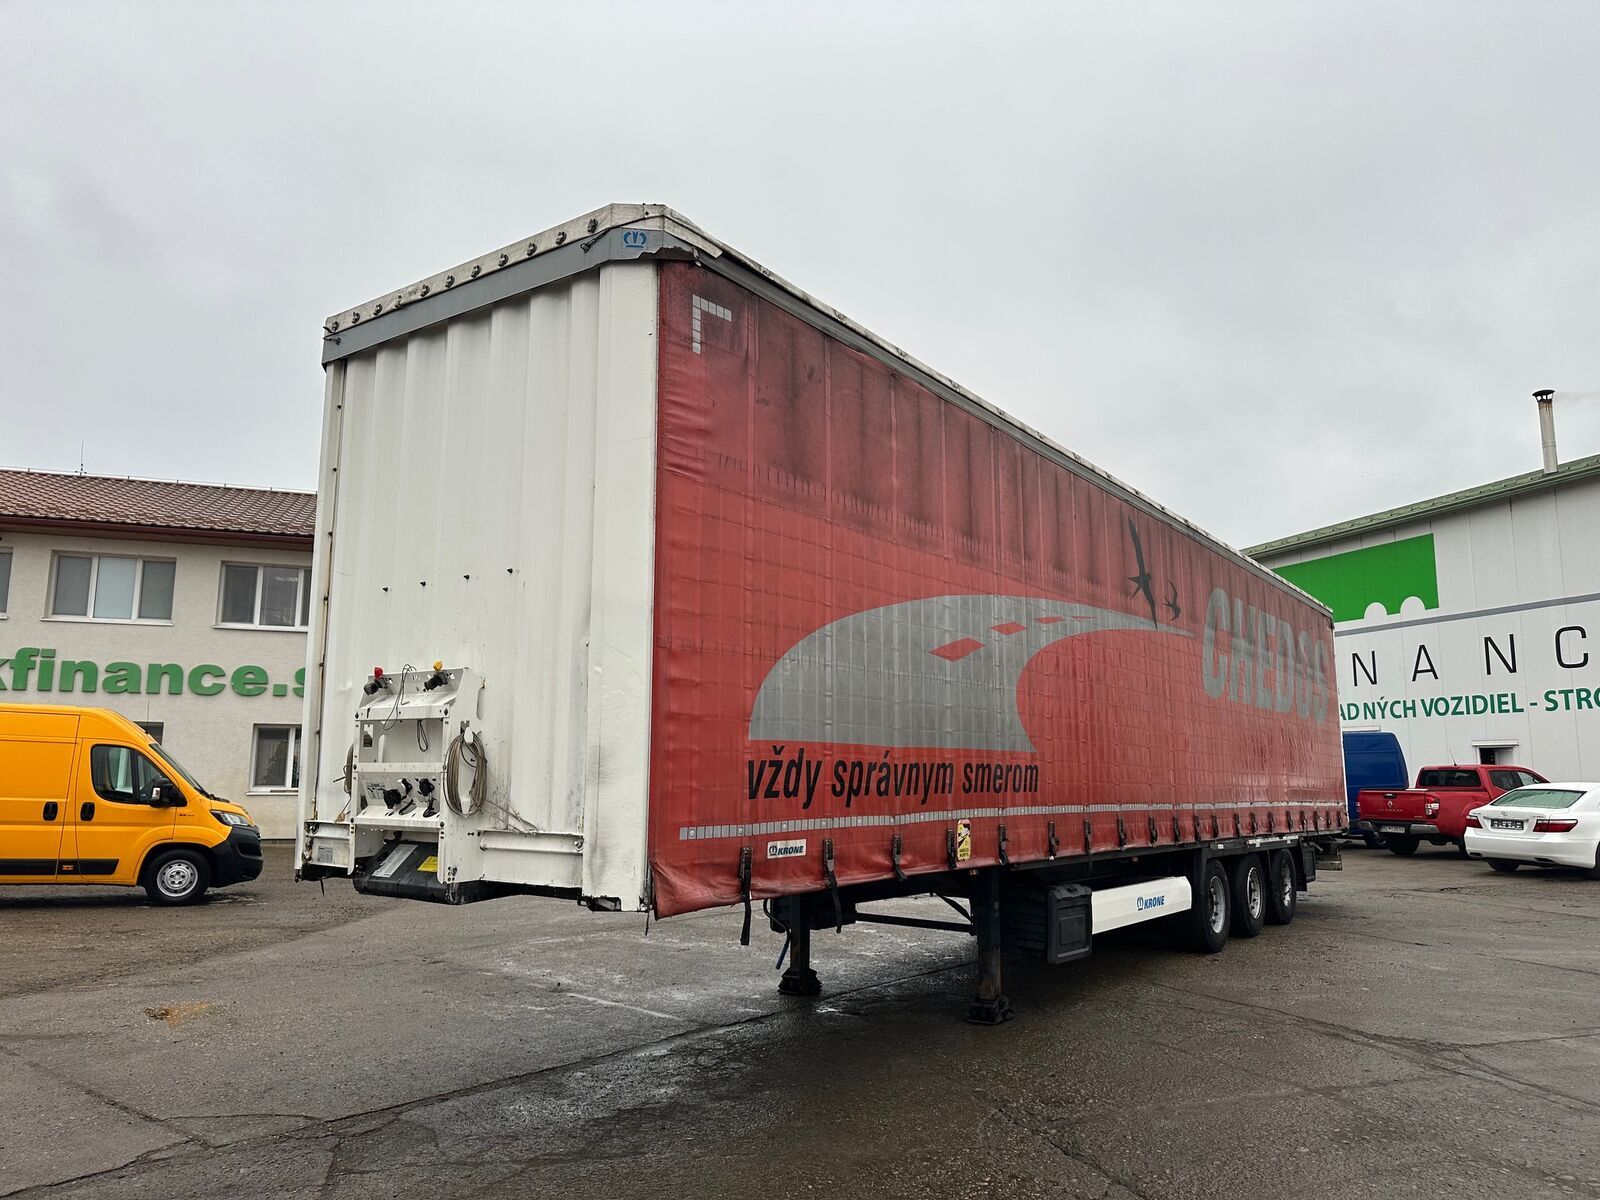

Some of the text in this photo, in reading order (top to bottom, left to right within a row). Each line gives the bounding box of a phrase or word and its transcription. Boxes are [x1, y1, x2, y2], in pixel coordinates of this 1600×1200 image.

[0, 647, 305, 697] finance.
[1202, 587, 1330, 725] CHEDOS
[1420, 692, 1524, 717] VOZIDIEL
[748, 745, 1039, 809] vždy správnym smerom
[777, 845, 804, 855] KRONE
[1144, 895, 1165, 910] KRONE
